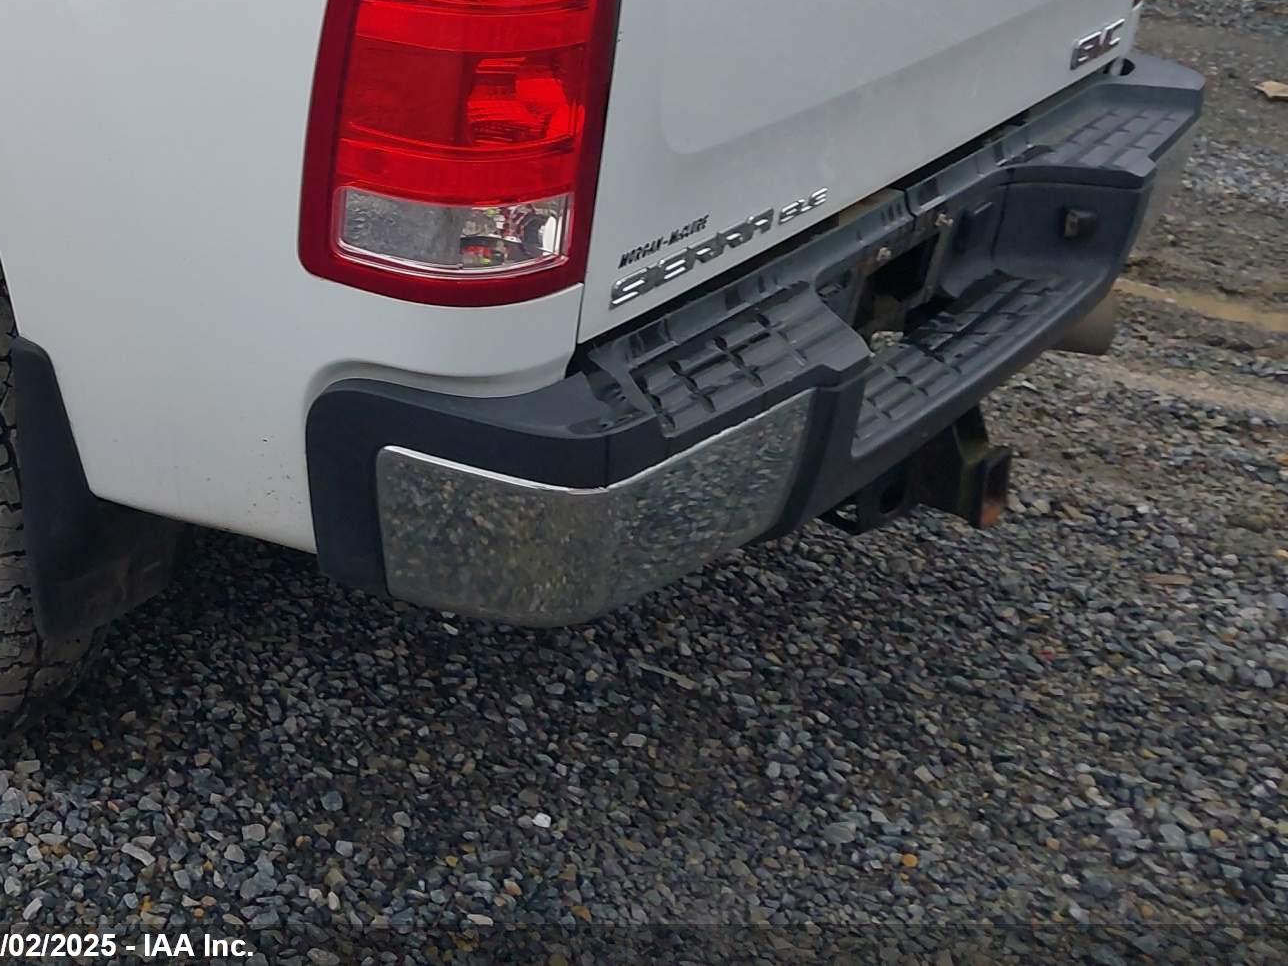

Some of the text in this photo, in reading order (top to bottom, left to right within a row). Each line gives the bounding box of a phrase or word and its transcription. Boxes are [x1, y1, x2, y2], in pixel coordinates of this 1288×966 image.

[1070, 18, 1126, 70] GMC
[609, 186, 829, 310] SIERRA SLE
